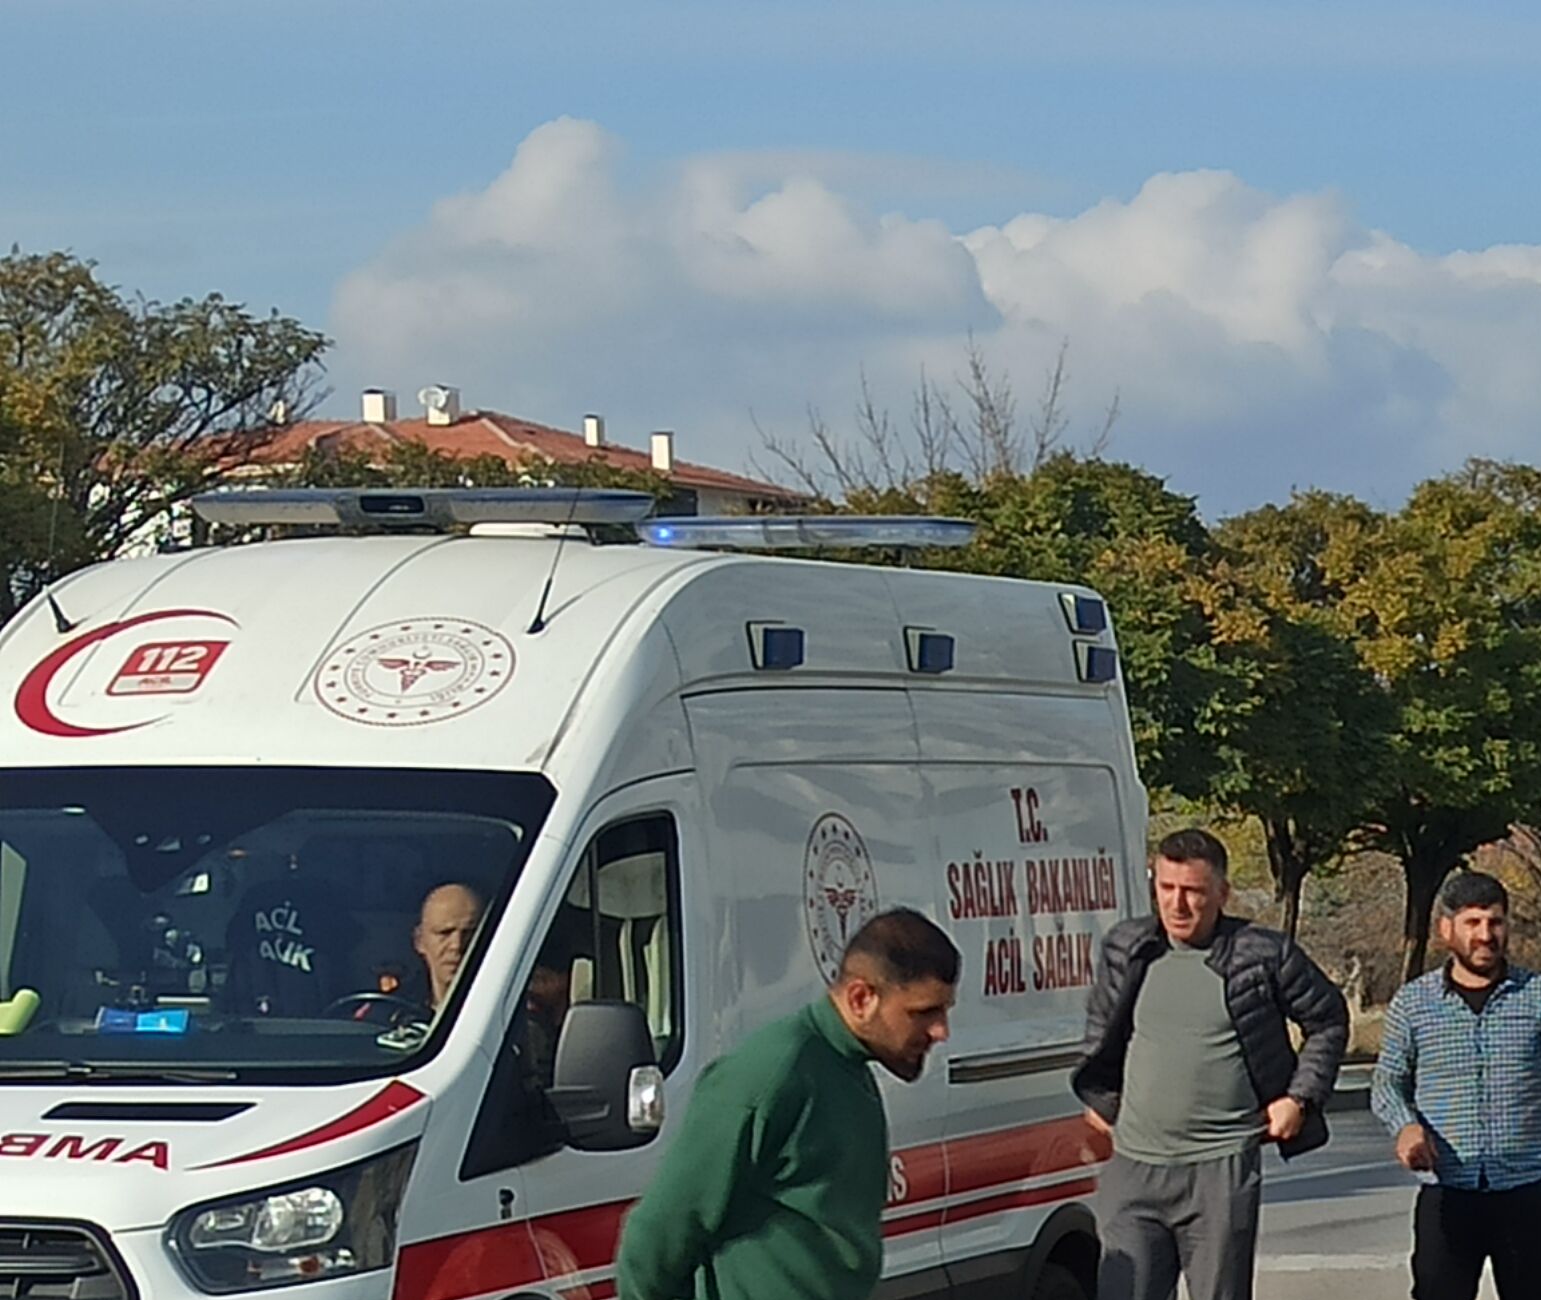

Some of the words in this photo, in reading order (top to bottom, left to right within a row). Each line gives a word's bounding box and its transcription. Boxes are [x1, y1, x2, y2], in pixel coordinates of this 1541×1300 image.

[136, 646, 208, 672] 112
[1010, 787, 1049, 843] T.C.
[947, 849, 1018, 920] SAĞLIK
[1025, 847, 1118, 915] BAKANLIĞI
[984, 927, 1026, 996] ACİL
[1033, 922, 1094, 990] SAĞLIK
